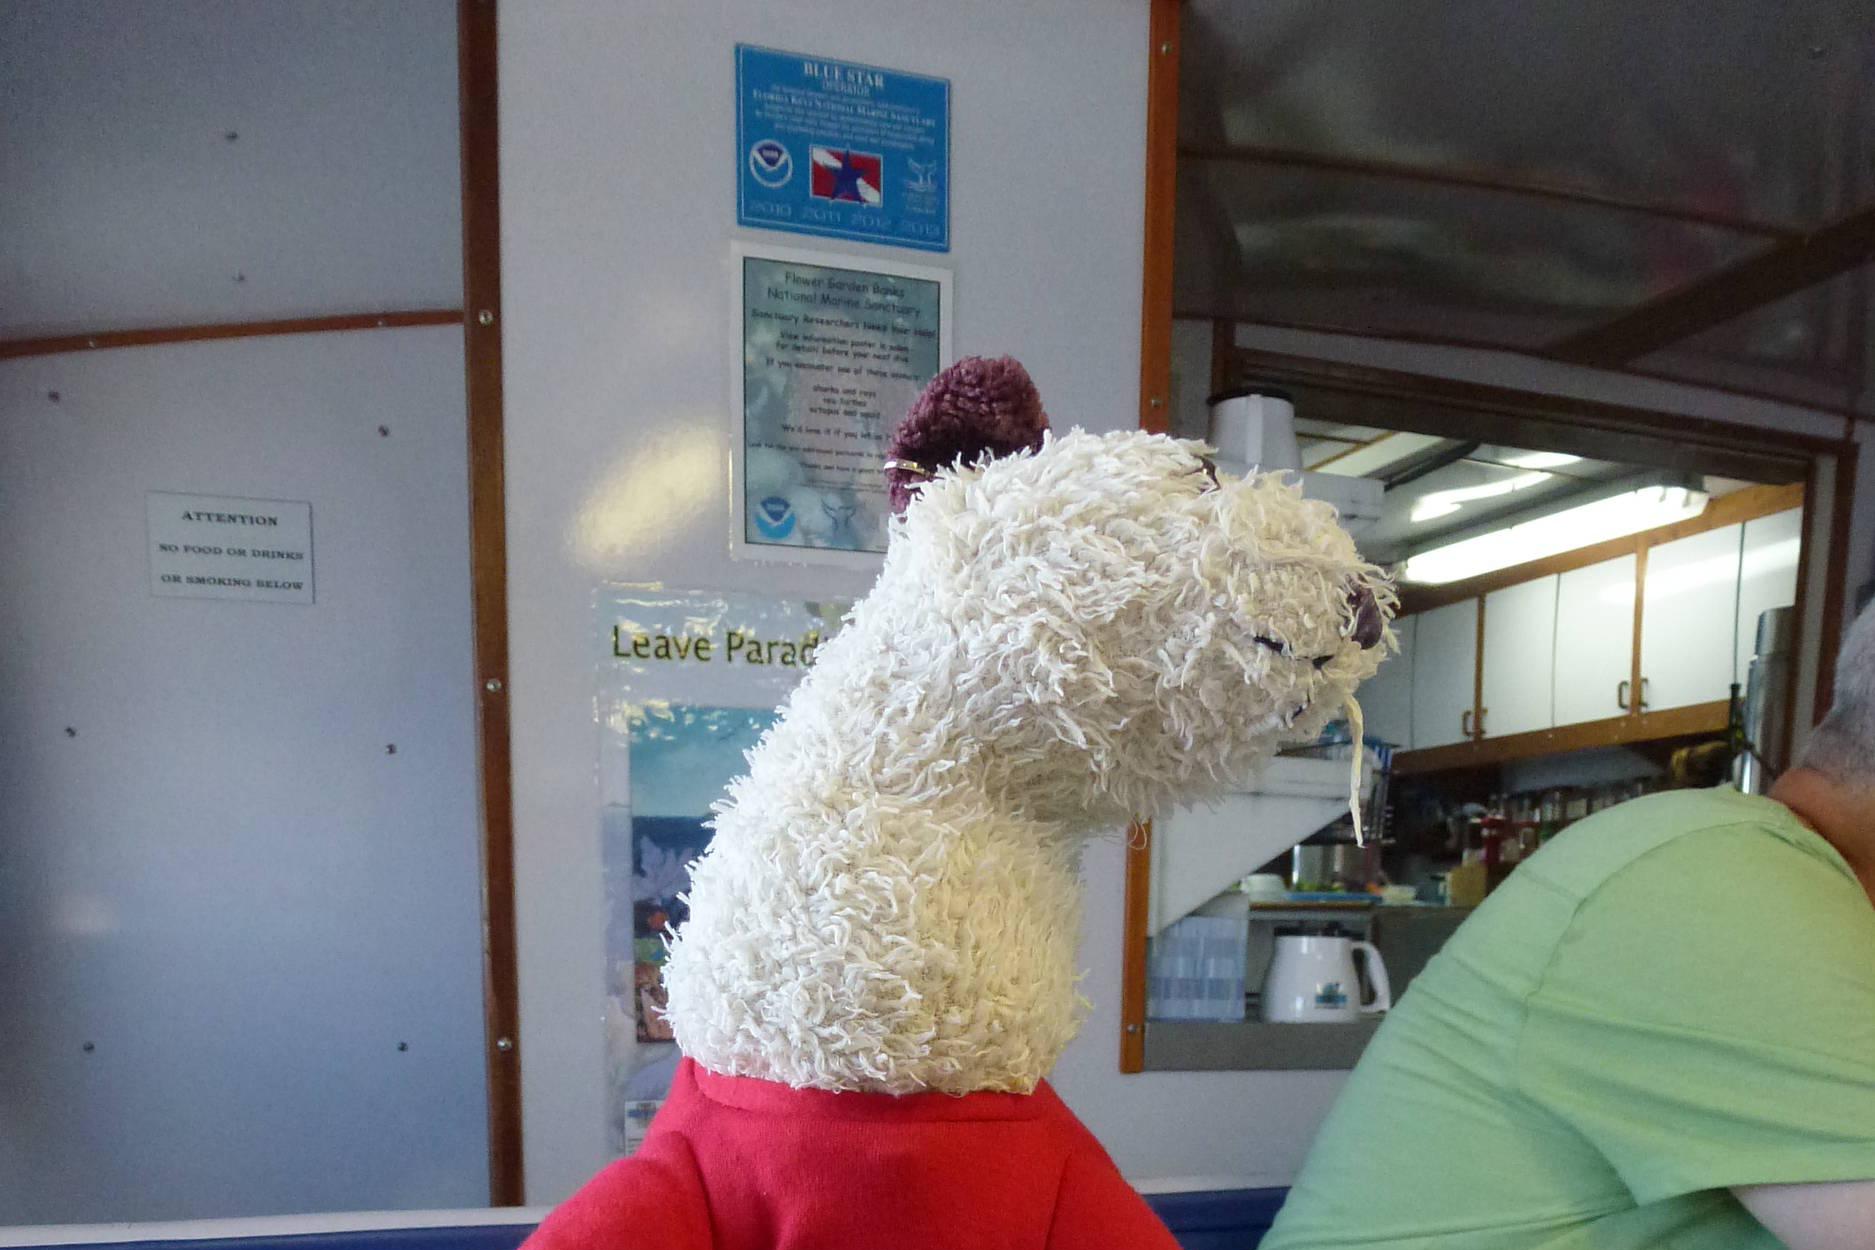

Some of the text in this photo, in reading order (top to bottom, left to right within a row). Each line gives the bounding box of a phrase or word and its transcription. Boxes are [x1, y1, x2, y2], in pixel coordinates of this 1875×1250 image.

[803, 62, 884, 88] BLUE STAR
[785, 271, 905, 298] Flower Garden Banks
[767, 287, 921, 318] National Marine Sanctuary
[751, 308, 799, 324] Sanctuary
[182, 511, 278, 526] ATTENTION
[159, 543, 304, 560] NO FOOD OR DRINKS
[161, 574, 303, 590] OR SMOKING BELOW
[613, 625, 828, 668] Leave Parad
